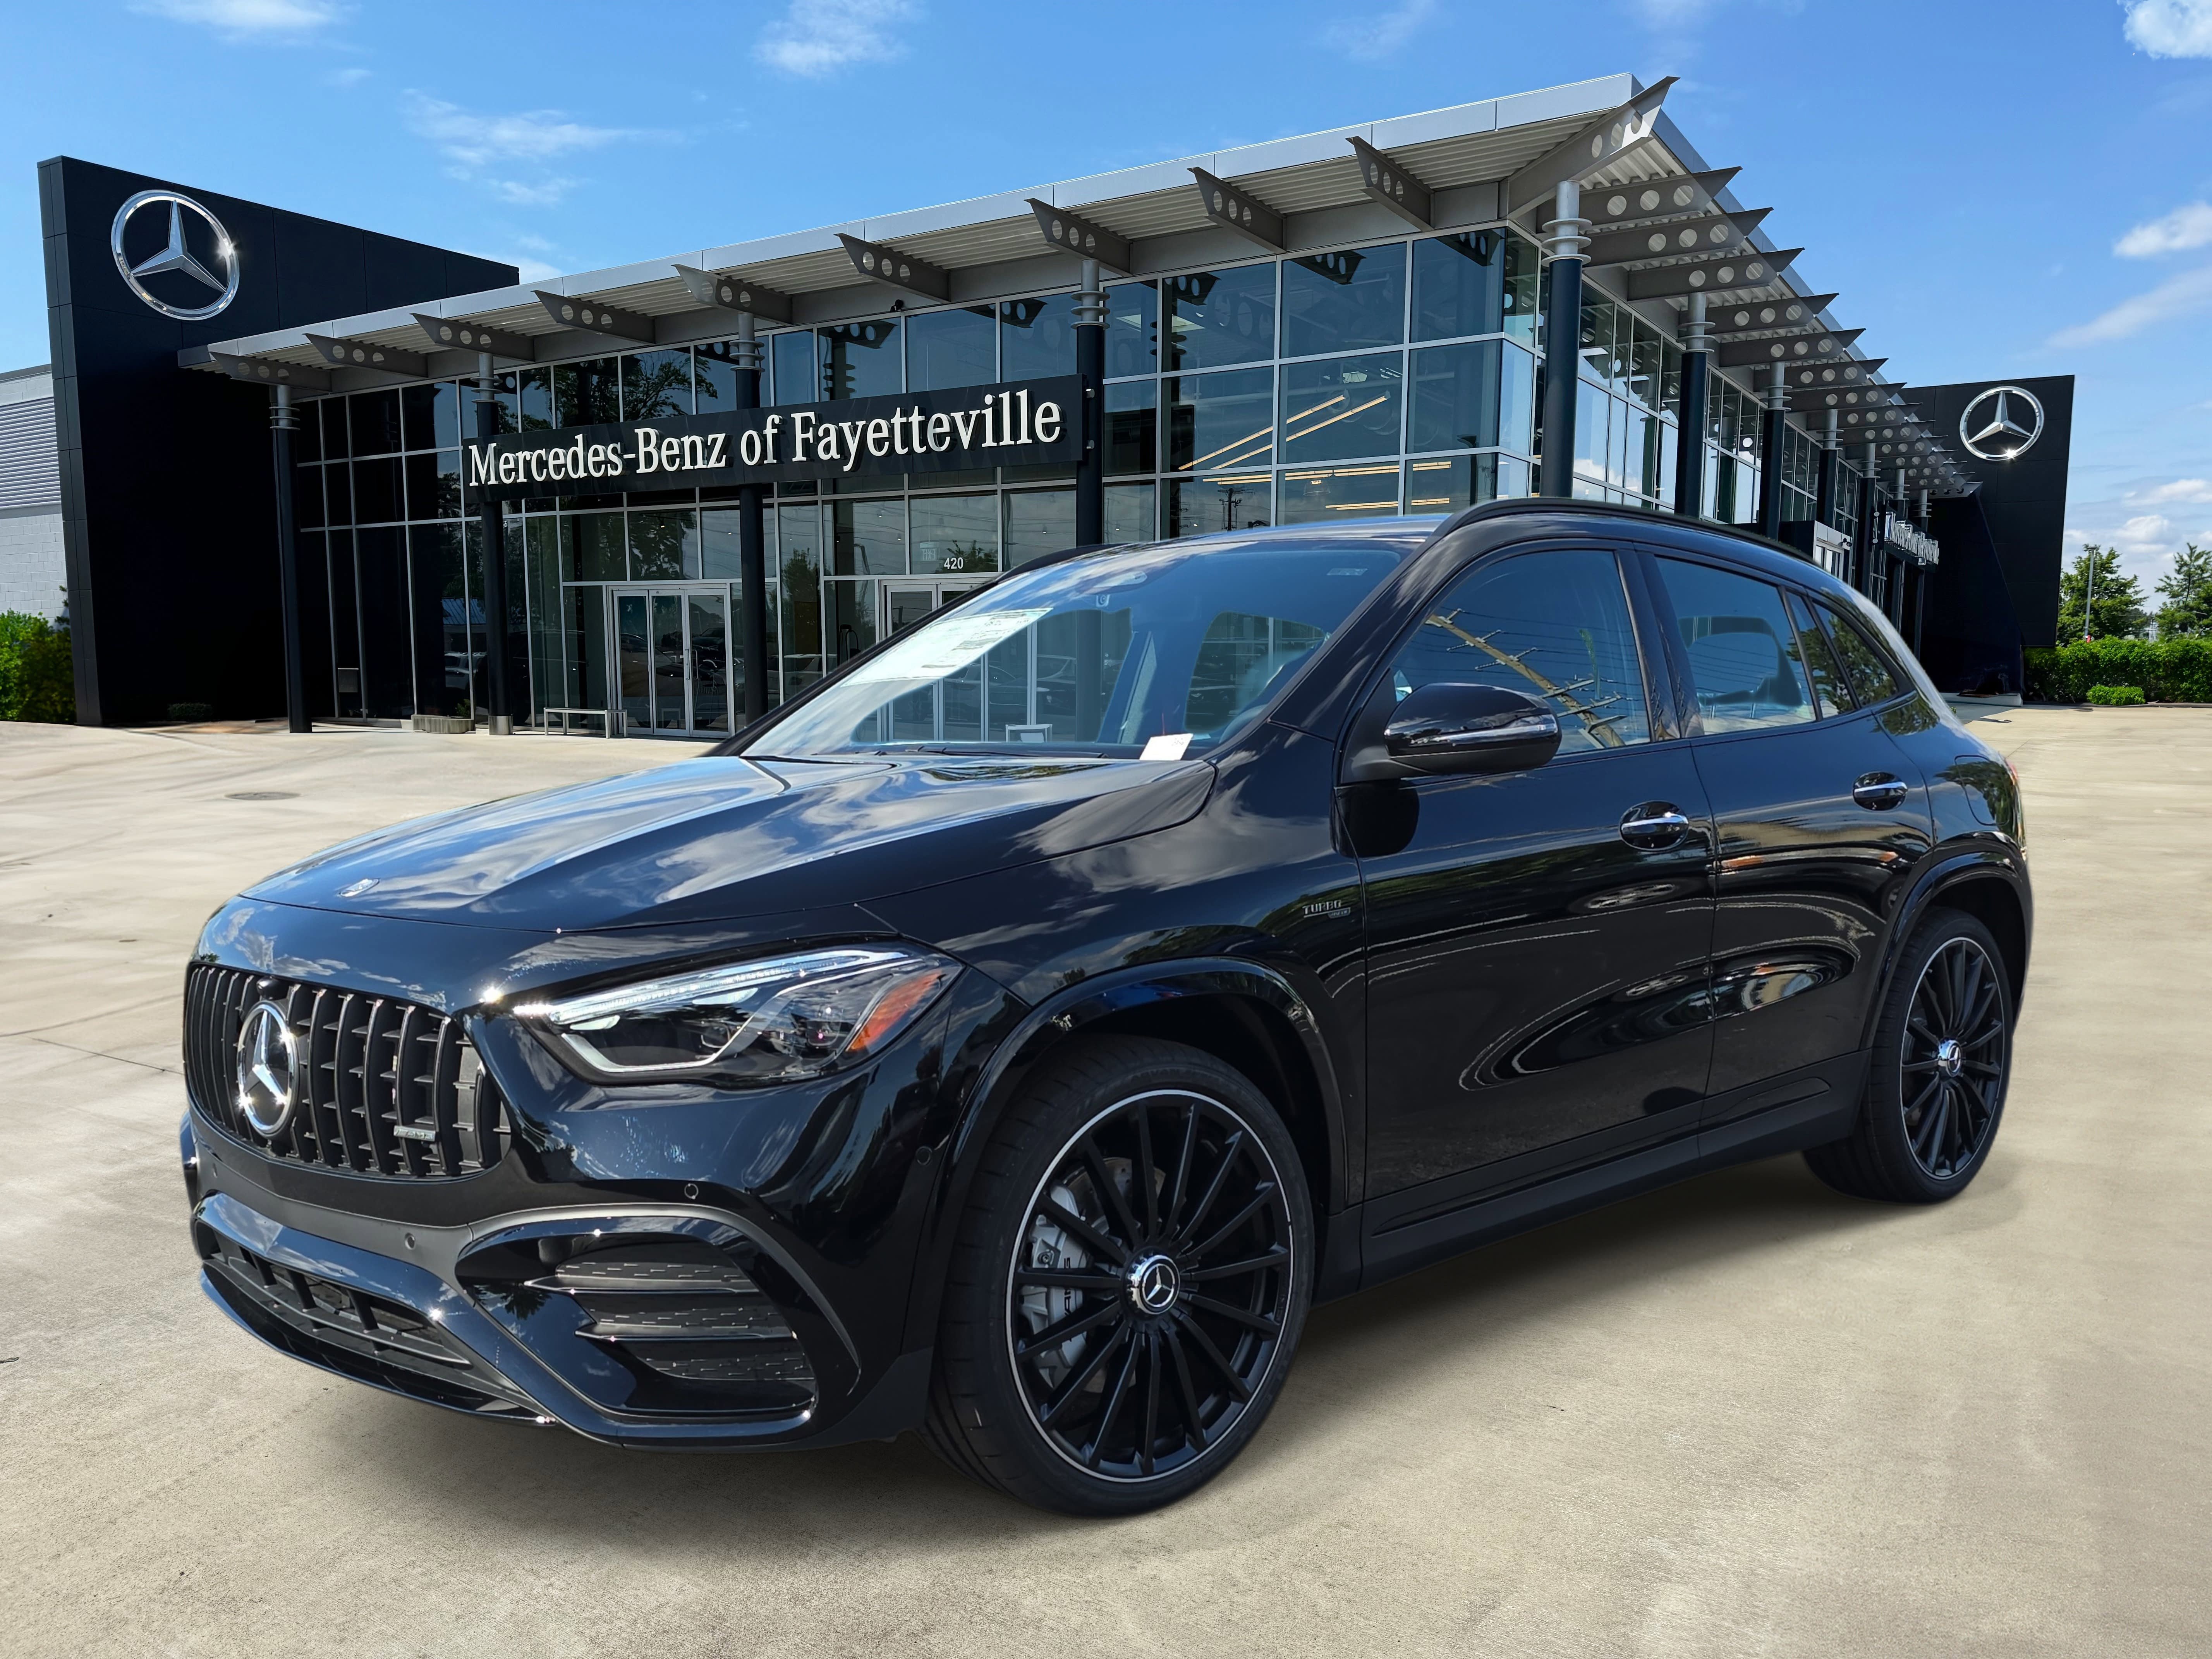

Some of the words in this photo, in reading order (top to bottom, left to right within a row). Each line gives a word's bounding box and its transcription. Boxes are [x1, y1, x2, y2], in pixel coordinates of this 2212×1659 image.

[469, 427, 727, 487] Mercedes-Benz
[740, 415, 783, 465] of
[790, 388, 1061, 472] Fayetteville
[944, 557, 964, 570] 420
[1302, 899, 1342, 915] TURBO
